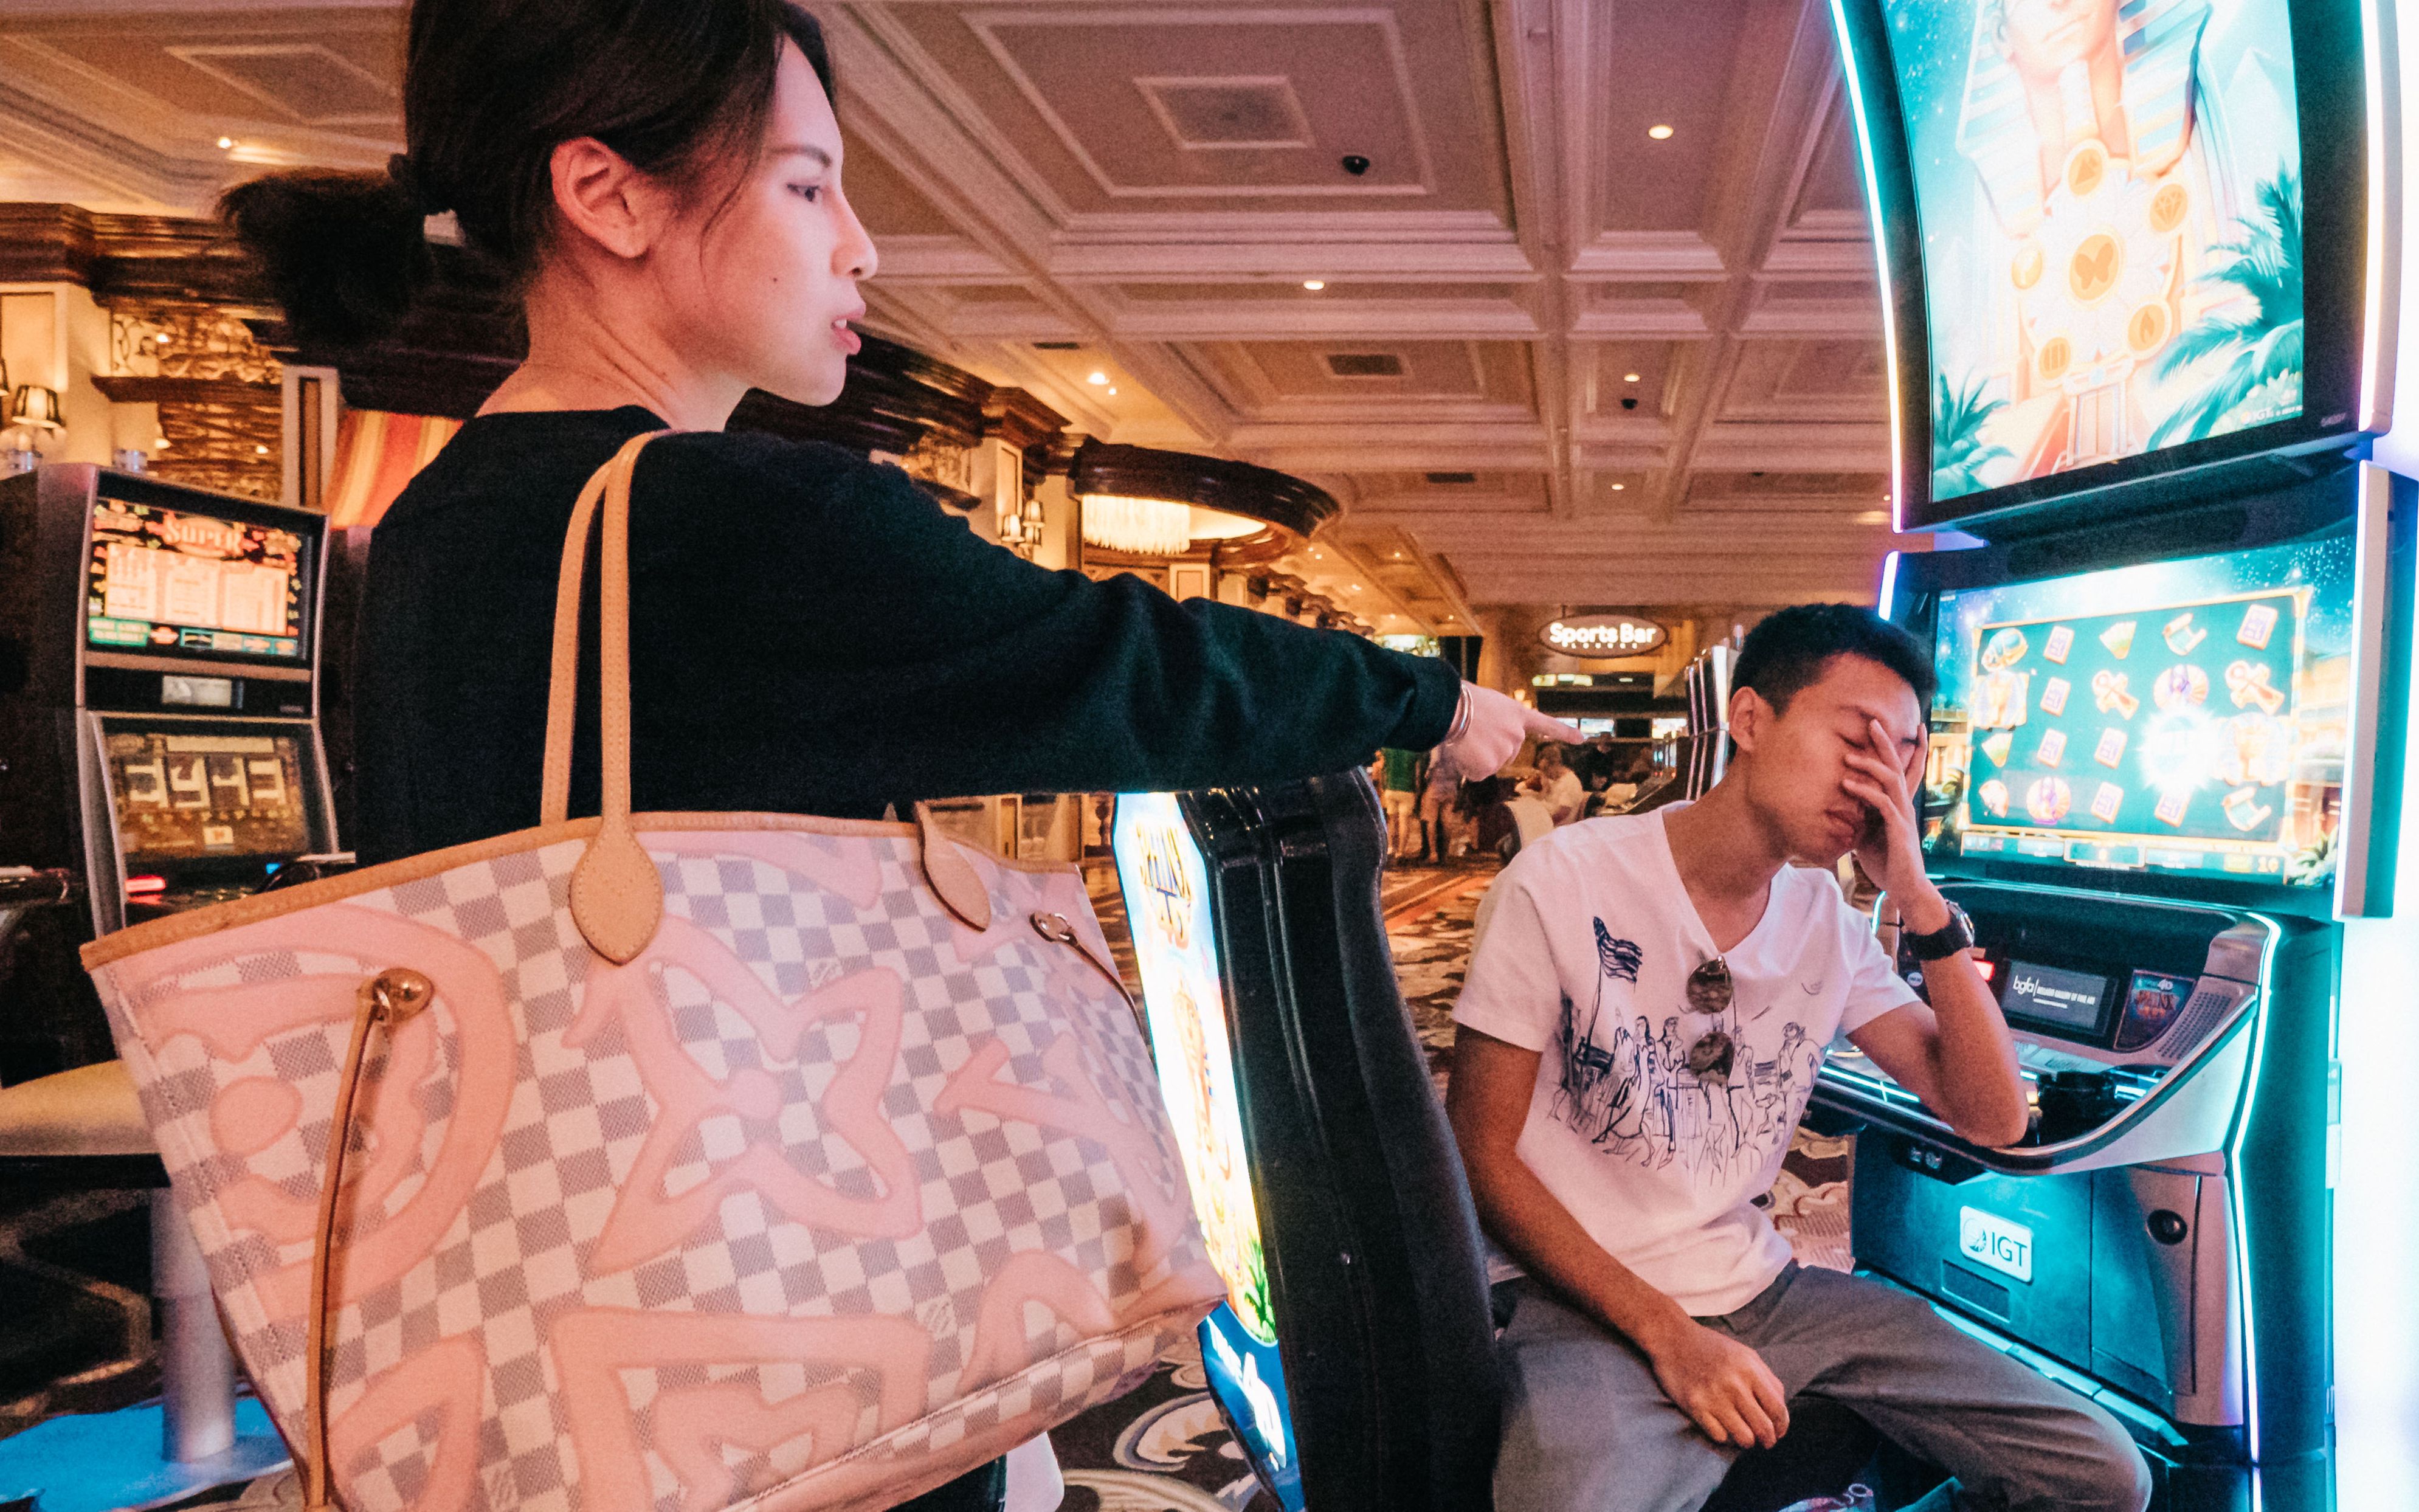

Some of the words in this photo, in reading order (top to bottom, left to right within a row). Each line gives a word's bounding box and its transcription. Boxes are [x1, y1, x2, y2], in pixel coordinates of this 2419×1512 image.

[1550, 622, 1618, 647] Sports
[1620, 623, 1657, 643] Bar
[1992, 1231, 2028, 1267] IGT
